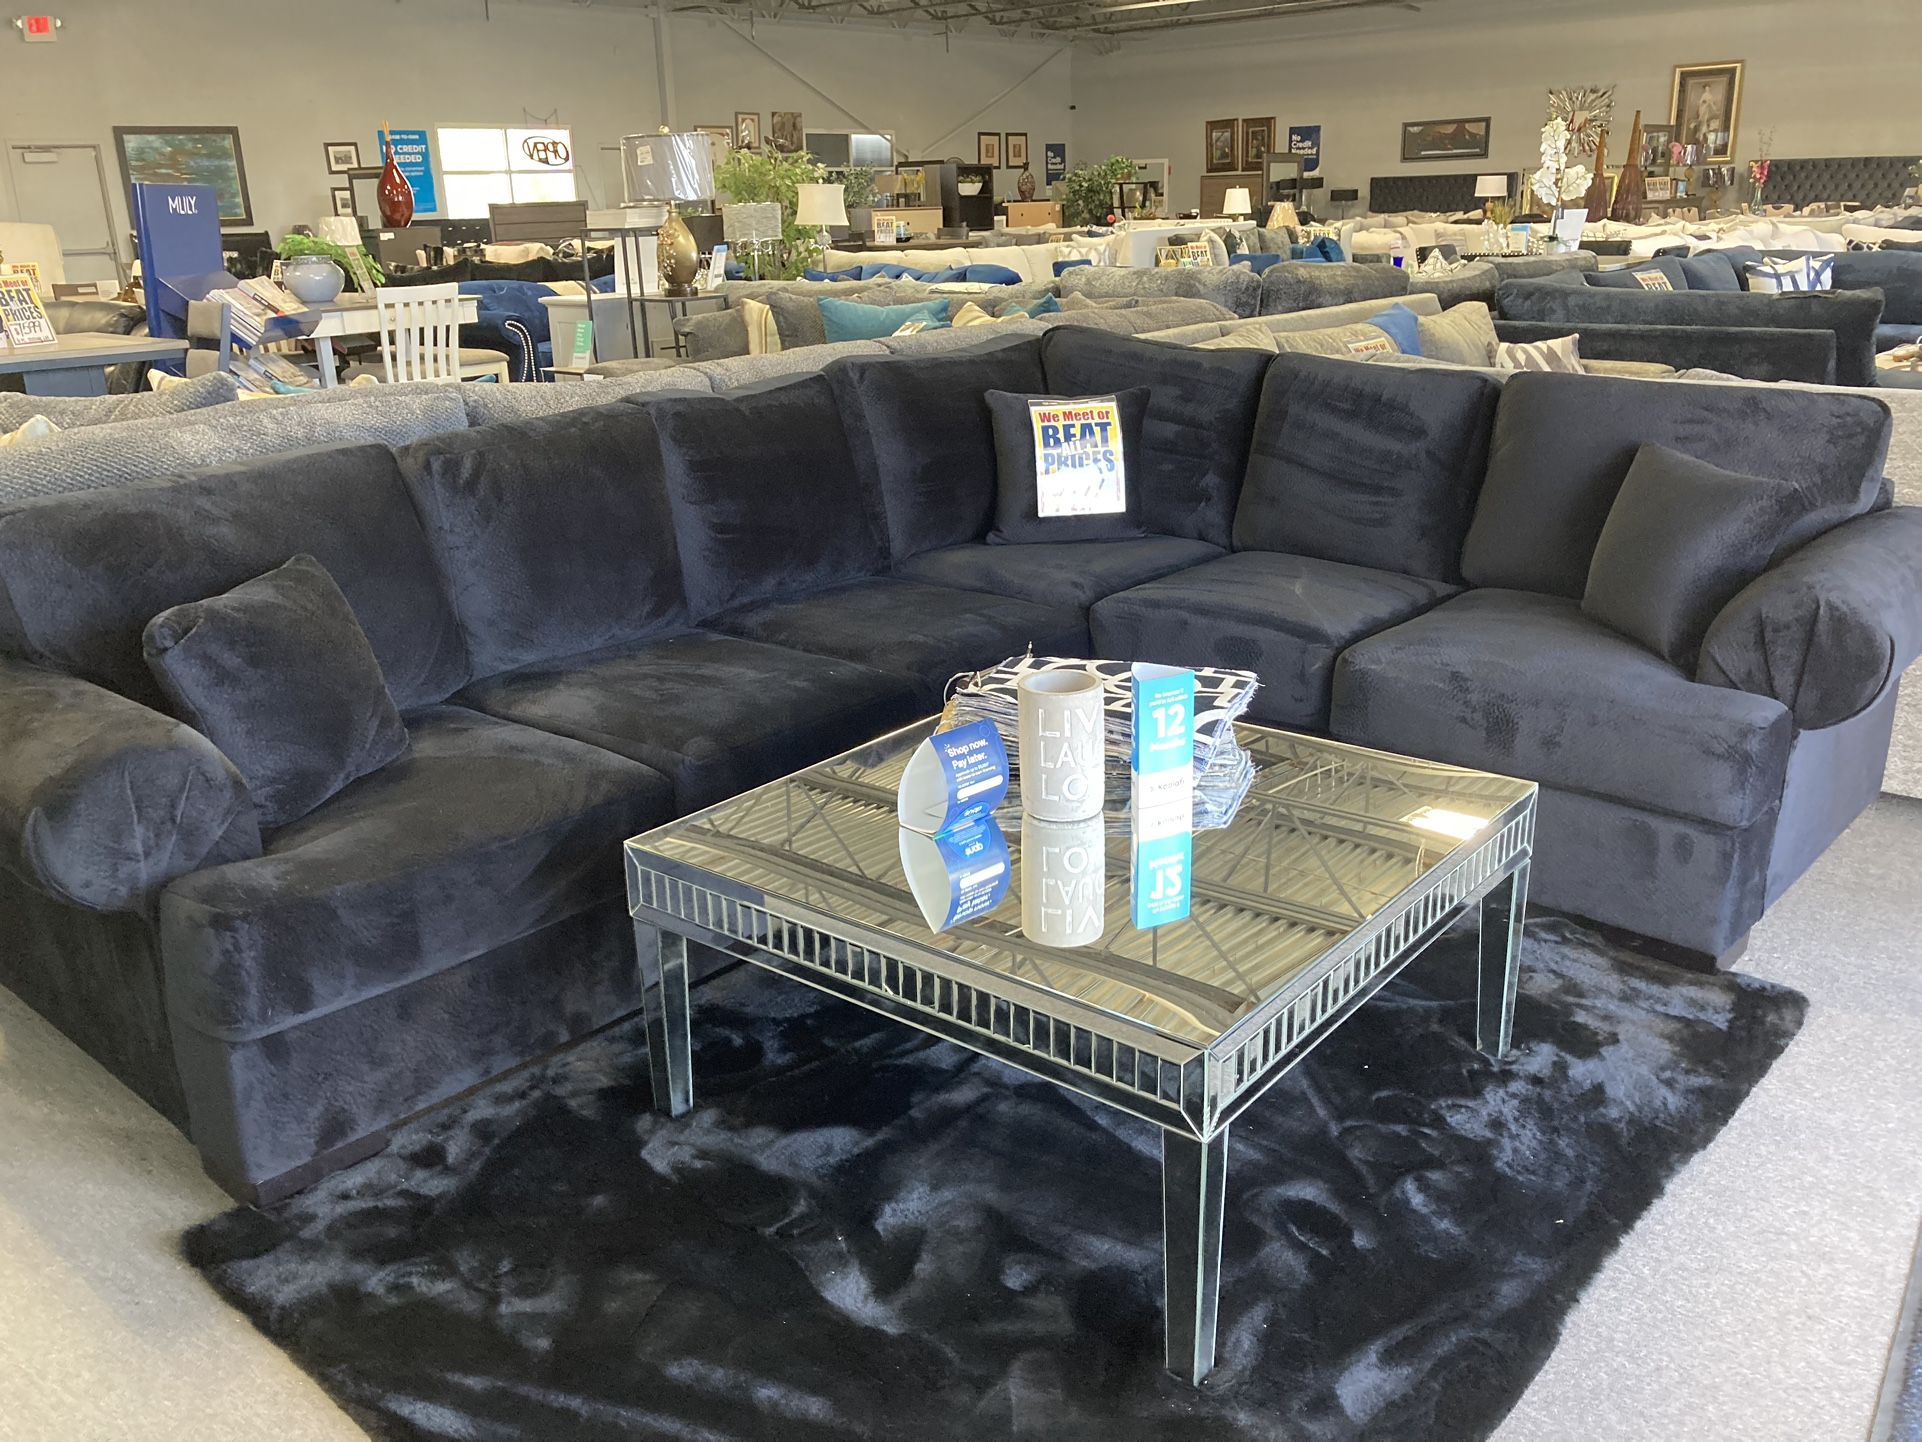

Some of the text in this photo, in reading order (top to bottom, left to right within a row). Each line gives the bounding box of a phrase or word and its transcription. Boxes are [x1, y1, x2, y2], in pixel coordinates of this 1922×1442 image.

[397, 144, 426, 152] CREDIT
[394, 154, 422, 162] EEDED
[0, 288, 35, 307] BEAT
[3, 305, 43, 322] PRICES
[1039, 410, 1110, 423] We Meet or
[1041, 422, 1112, 451] BEAT
[1043, 449, 1115, 475] PRICES
[1152, 703, 1186, 738] 12
[947, 739, 989, 757] Shop now.
[952, 752, 988, 770] Pay later.
